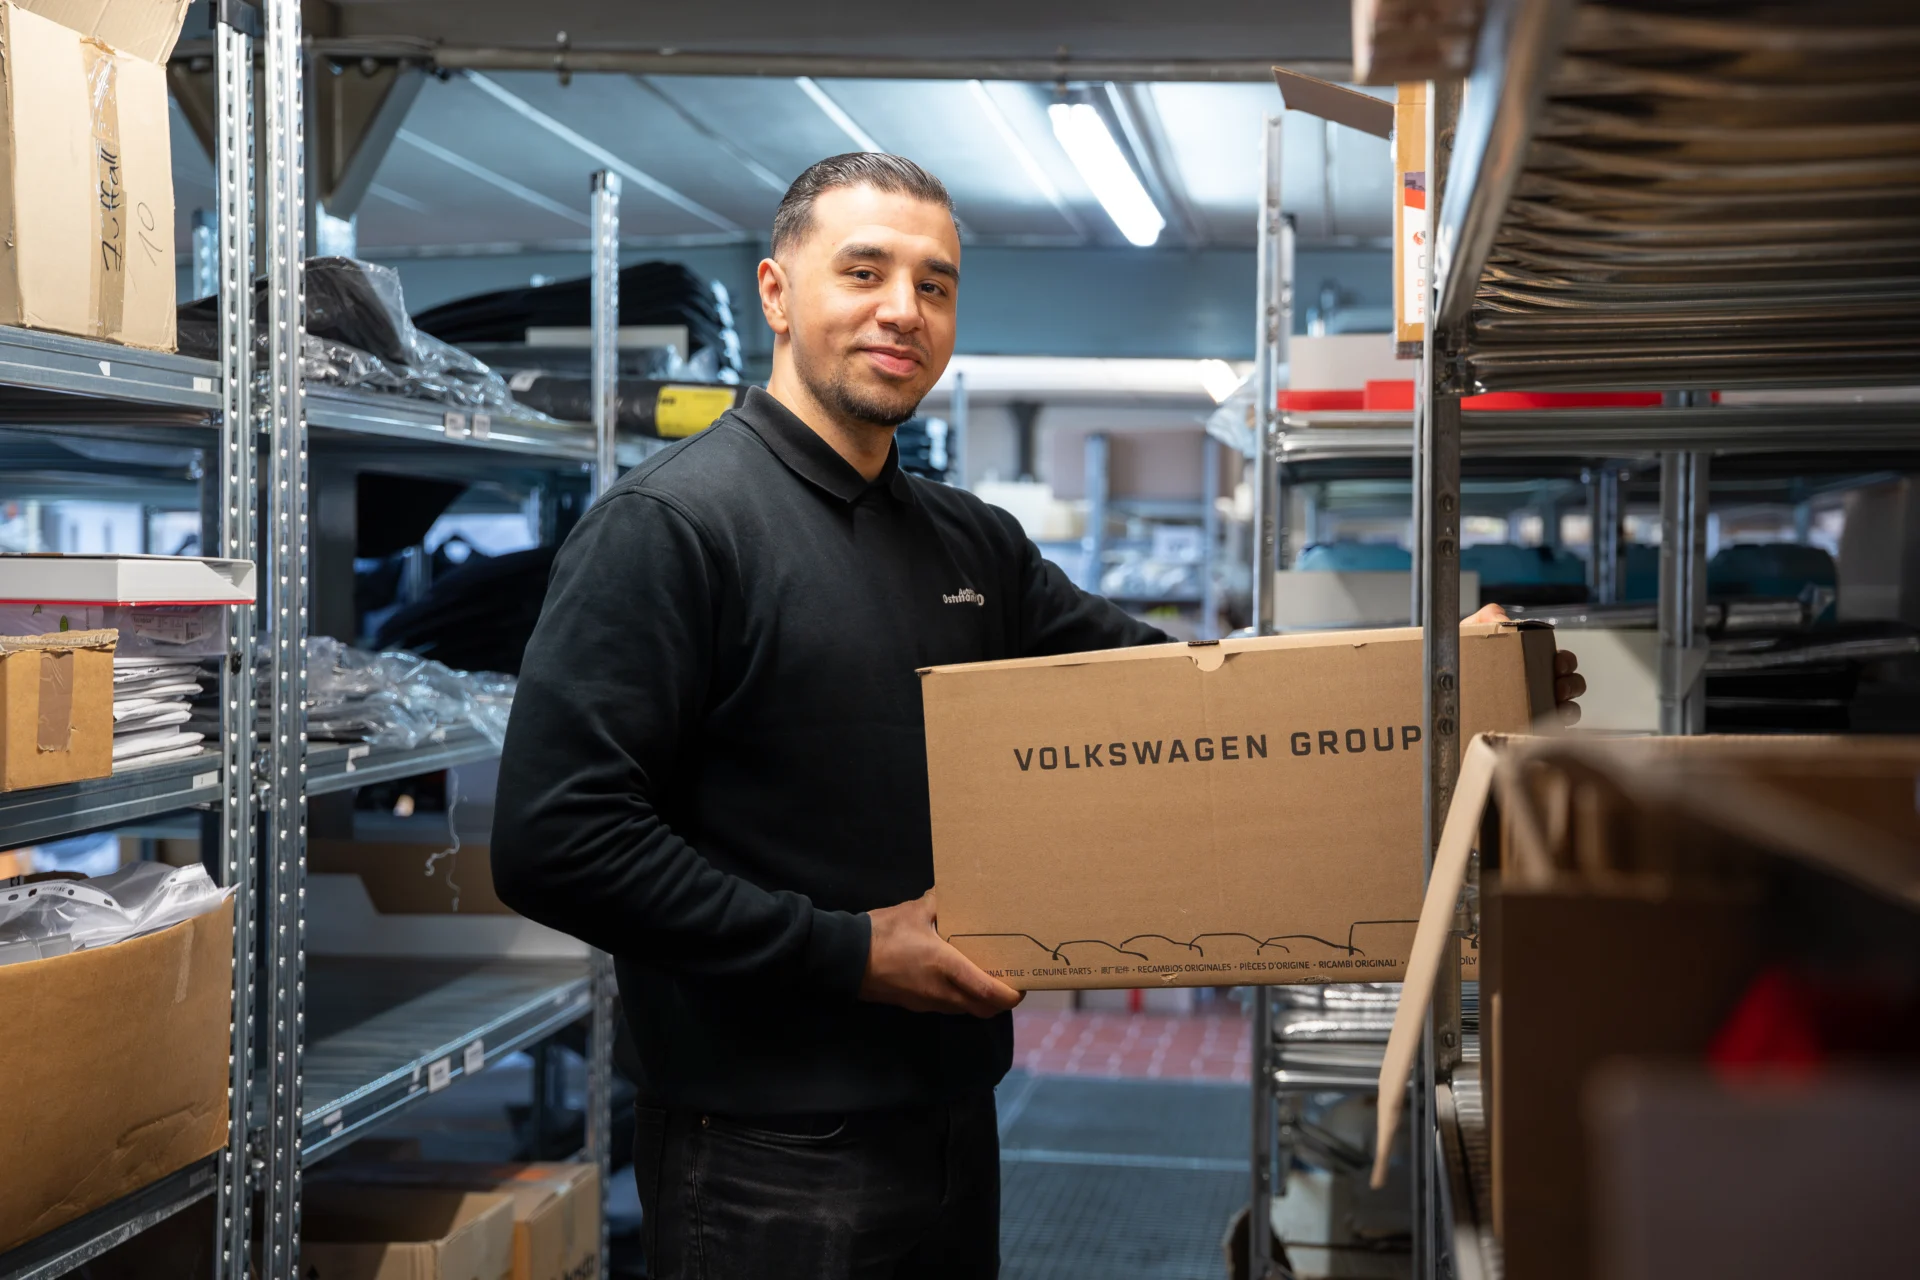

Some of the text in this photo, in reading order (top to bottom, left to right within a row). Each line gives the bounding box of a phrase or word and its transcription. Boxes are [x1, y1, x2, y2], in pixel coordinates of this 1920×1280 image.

[1013, 725, 1422, 772] VOLKSWAGEN GROUP
[1005, 969, 1025, 977] TEILE
[1032, 968, 1068, 976] GENUINE
[1069, 967, 1092, 975] PARTS
[1137, 964, 1183, 973] RECAMBIOS
[1184, 963, 1232, 972] ORIGINALES
[1240, 961, 1267, 970] PIÈCES
[1268, 961, 1310, 970] D'ORIGINE
[1318, 960, 1353, 969] RICAMBI
[1354, 959, 1397, 968] ORIGINALI
